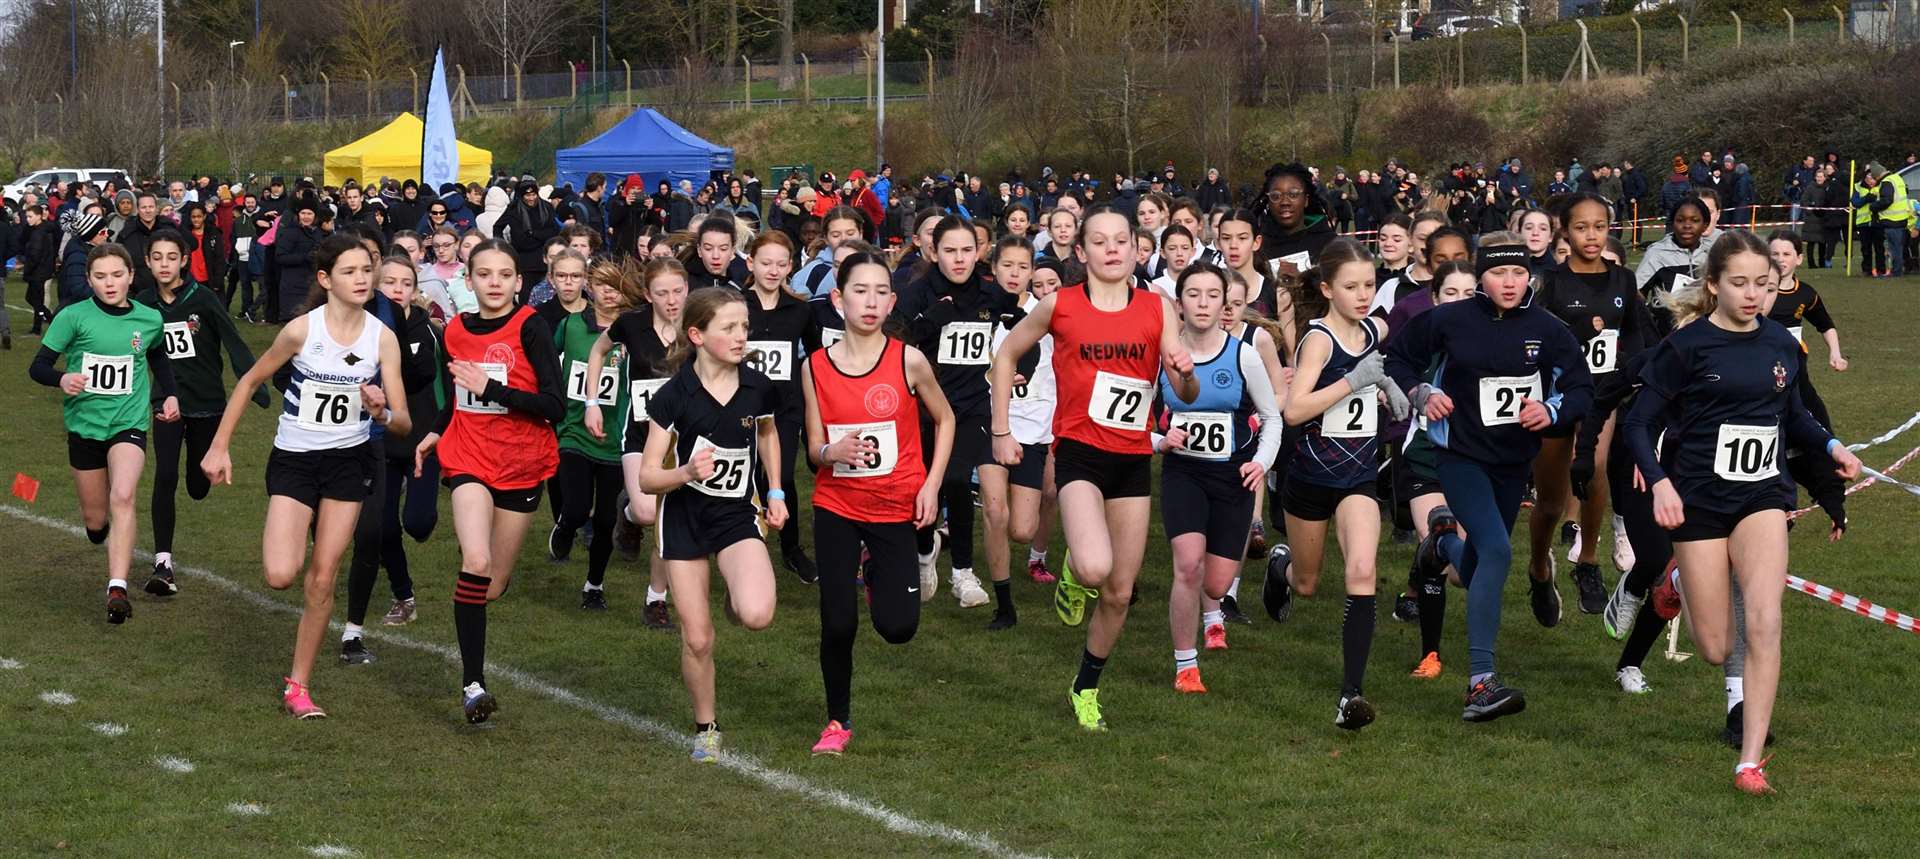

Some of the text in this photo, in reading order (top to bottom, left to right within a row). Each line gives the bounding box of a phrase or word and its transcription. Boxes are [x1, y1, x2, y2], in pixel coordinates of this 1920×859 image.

[164, 330, 189, 355] 03
[947, 331, 985, 359] 119
[1080, 343, 1147, 360] MEDWAY
[88, 363, 127, 389] 101
[575, 371, 614, 400] 12
[315, 392, 349, 424] 76
[1106, 386, 1142, 423] 72
[1346, 397, 1364, 431] 2
[1496, 386, 1532, 417] 27
[1724, 437, 1776, 474] 104
[700, 458, 745, 490] 25
